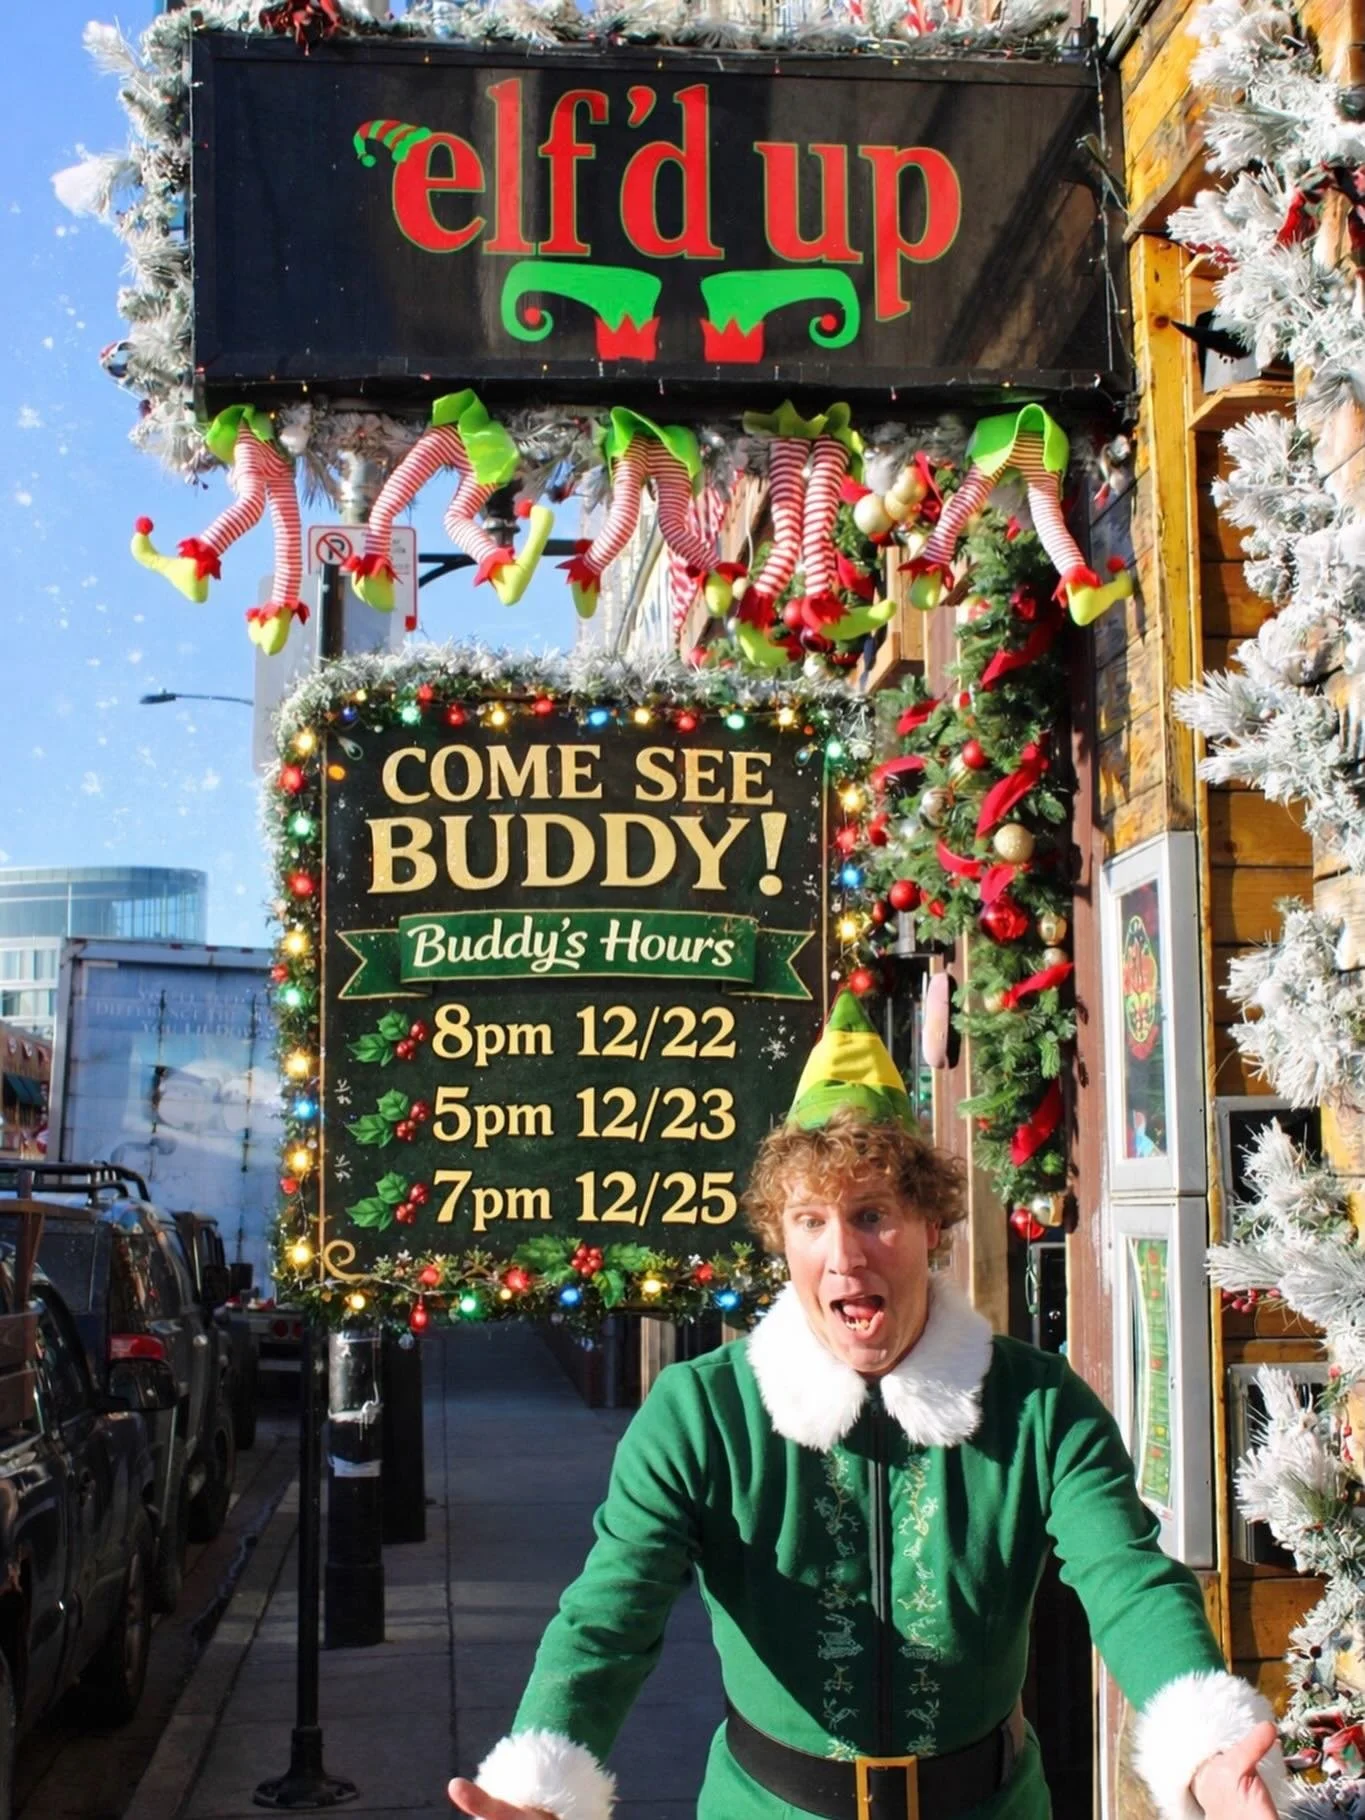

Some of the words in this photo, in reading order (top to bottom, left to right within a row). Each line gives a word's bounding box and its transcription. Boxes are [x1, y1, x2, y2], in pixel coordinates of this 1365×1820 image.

[392, 77, 725, 260] elf'd
[754, 141, 962, 321] up
[381, 743, 603, 803] COME
[635, 746, 775, 806] SEE
[364, 811, 788, 897] BUDDY!
[406, 914, 588, 974] Buddy's
[600, 918, 735, 967] Hours
[431, 1003, 554, 1068] 8pm
[575, 1005, 737, 1061] 12/22
[432, 1086, 554, 1148] 5pm
[575, 1087, 737, 1143] 12/23
[433, 1170, 553, 1232] 7pm
[575, 1171, 738, 1227] 12/25
